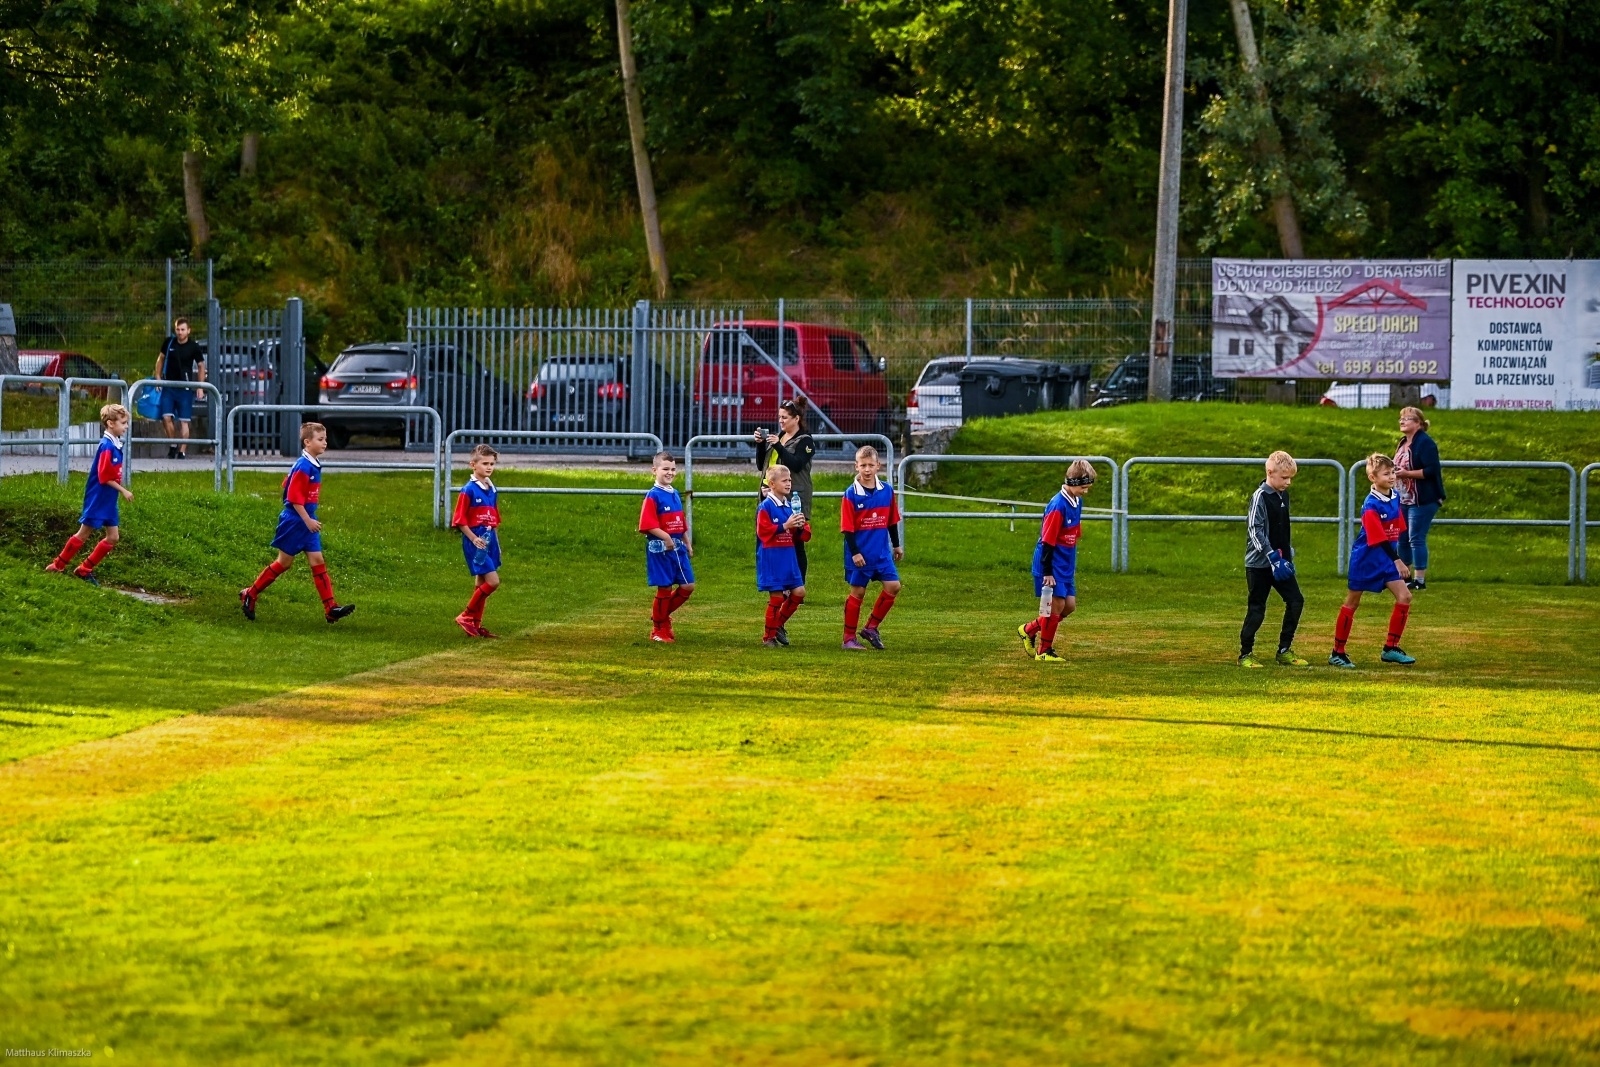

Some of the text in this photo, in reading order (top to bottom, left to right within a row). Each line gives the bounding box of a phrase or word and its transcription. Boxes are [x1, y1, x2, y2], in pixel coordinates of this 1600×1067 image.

[1217, 265, 1268, 278] USŁUGI
[1271, 266, 1352, 278] CIESIELSKO
[1364, 264, 1447, 278] DEKARSKIE
[1217, 279, 1343, 293] DOMY POD KLUCZ
[1466, 273, 1566, 295] PIVEXIN
[1467, 296, 1565, 308] TECHNOLOGY
[1334, 315, 1419, 334] SPEED-DACH
[1489, 322, 1542, 334] DOSTAWCA
[1477, 337, 1553, 351] KOMPONENTÓW
[1315, 360, 1438, 375] tel. 698 650 692
[1483, 354, 1547, 370] I ROZWIĄZAŃ
[1475, 374, 1555, 386] DLA PRZEMYSŁU
